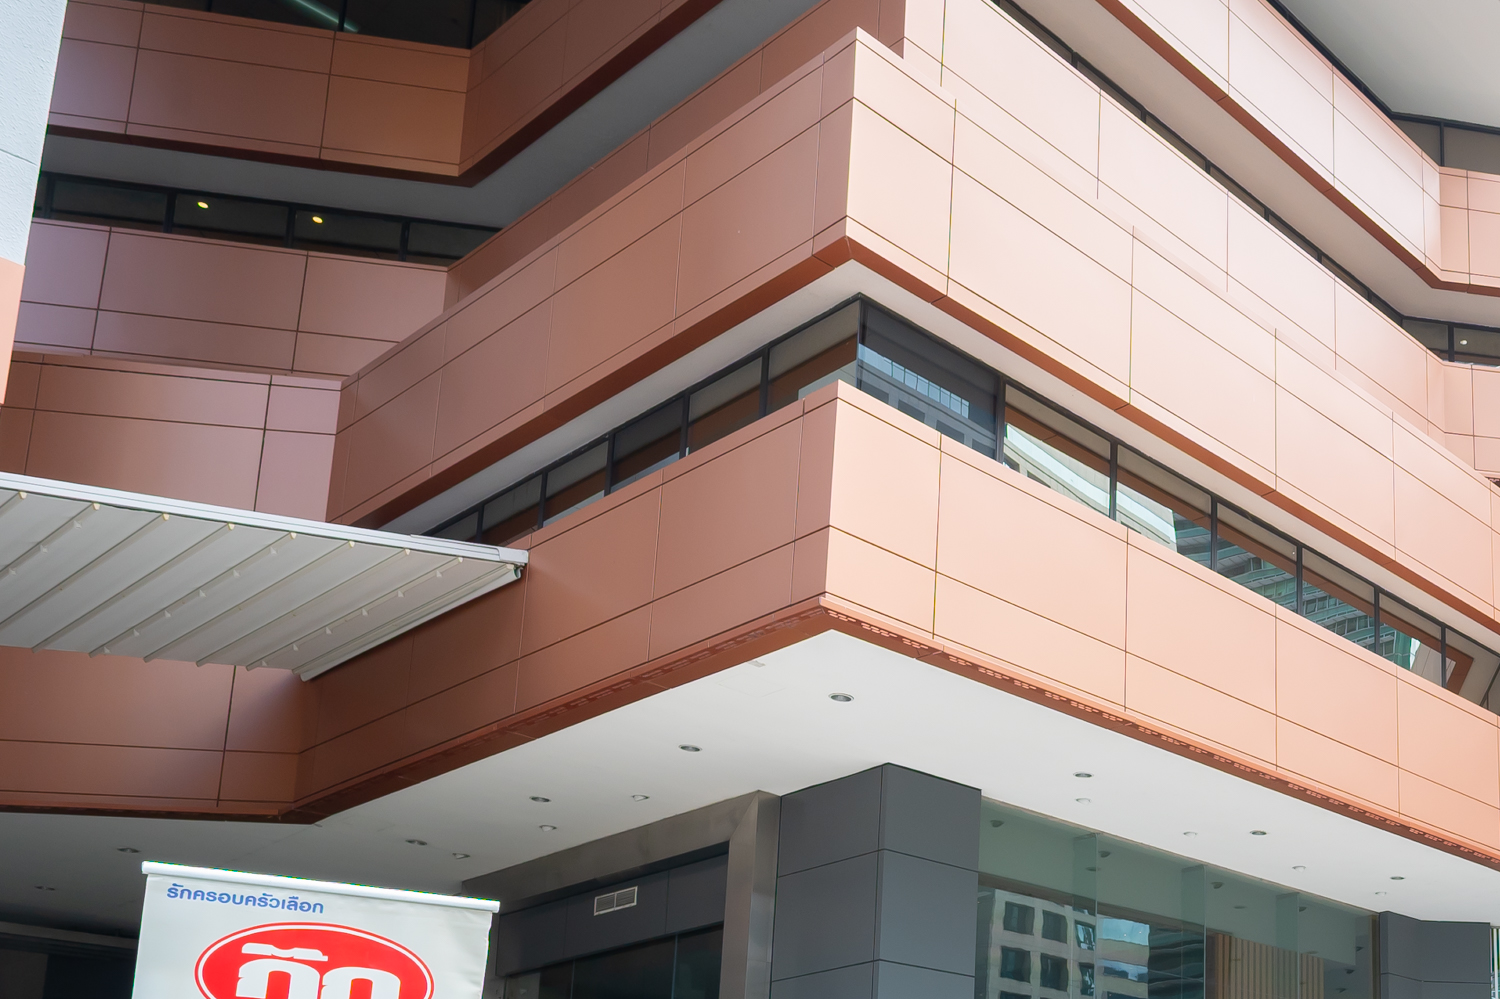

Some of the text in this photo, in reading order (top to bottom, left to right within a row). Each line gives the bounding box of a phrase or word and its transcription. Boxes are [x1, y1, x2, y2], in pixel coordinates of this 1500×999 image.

[167, 883, 324, 914] รักครอบครัวเลือก
